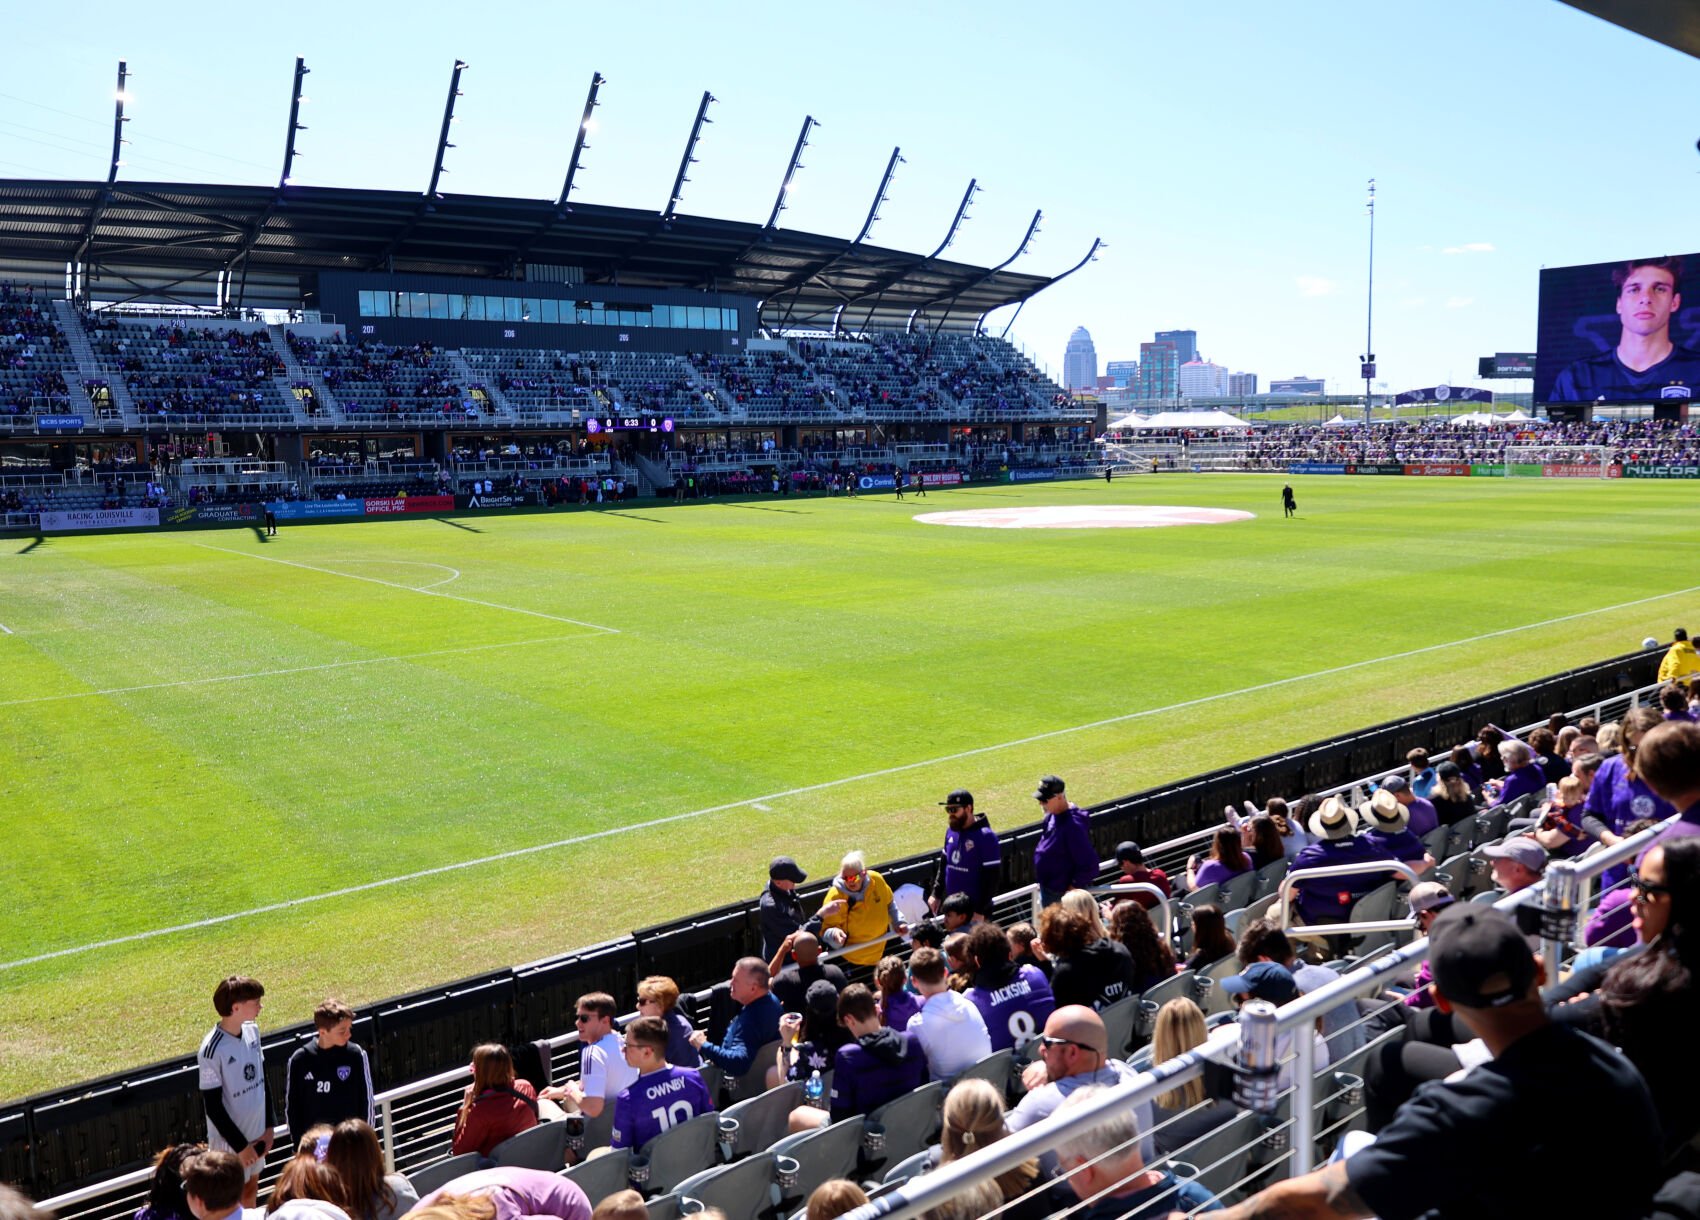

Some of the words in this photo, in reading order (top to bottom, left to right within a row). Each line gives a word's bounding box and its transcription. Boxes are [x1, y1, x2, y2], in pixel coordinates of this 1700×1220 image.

[362, 325, 374, 334] 207
[606, 418, 612, 427] 0
[624, 418, 639, 427] 6:33
[650, 418, 656, 427] 0
[1356, 464, 1379, 473] Health
[1626, 466, 1699, 475] NUCOR
[67, 512, 93, 520] RACING
[96, 510, 134, 519] LOUISVILLE
[198, 510, 239, 519] GRADUATE
[990, 979, 1032, 1007] JACKSON
[1104, 981, 1123, 997] CITY
[1008, 1010, 1037, 1050] 8
[316, 1080, 331, 1094] 20
[646, 1075, 685, 1100] OWNBY
[651, 1099, 694, 1133] 10
